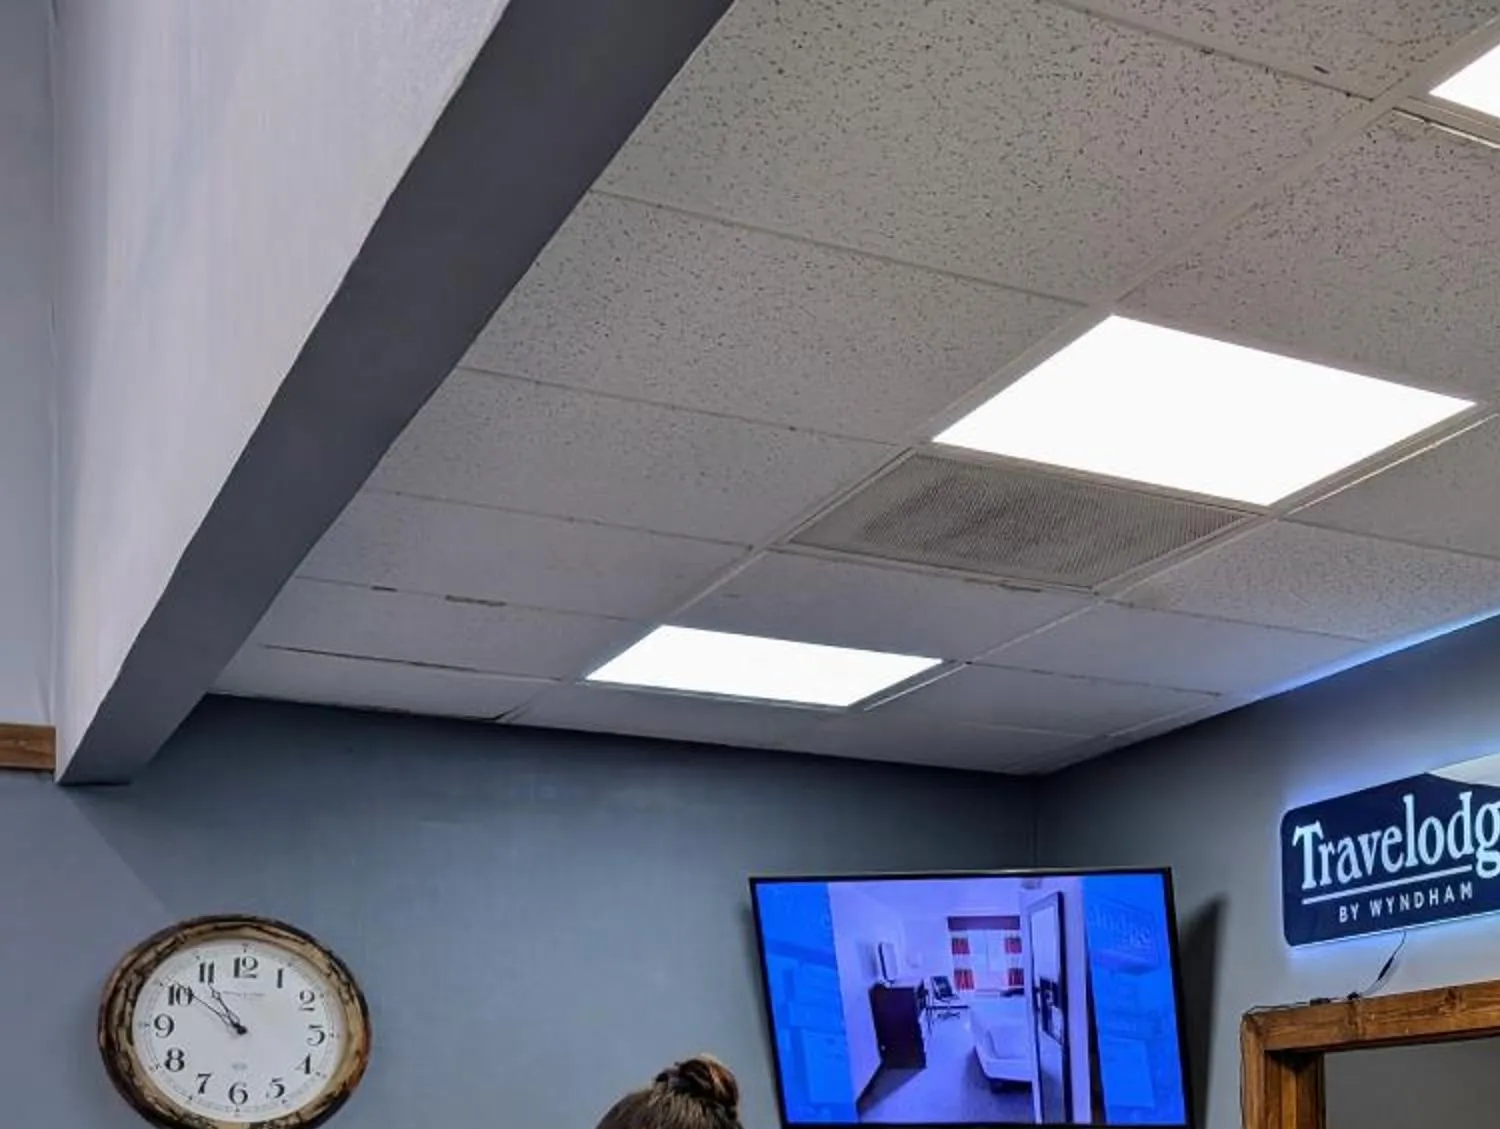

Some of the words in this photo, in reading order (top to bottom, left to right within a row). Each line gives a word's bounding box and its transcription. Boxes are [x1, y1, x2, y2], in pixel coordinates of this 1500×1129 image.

[1339, 904, 1361, 923] BY
[1369, 881, 1474, 918] WYNDHAM
[199, 961, 215, 983] 11
[233, 956, 259, 979] 12
[276, 968, 284, 989] 1
[298, 990, 316, 1011] 2
[153, 1013, 175, 1038] 9
[164, 1048, 186, 1072] 8
[294, 1053, 312, 1075] 4
[196, 1072, 213, 1095] 7
[228, 1082, 249, 1106] 6
[265, 1078, 286, 1099] 5
